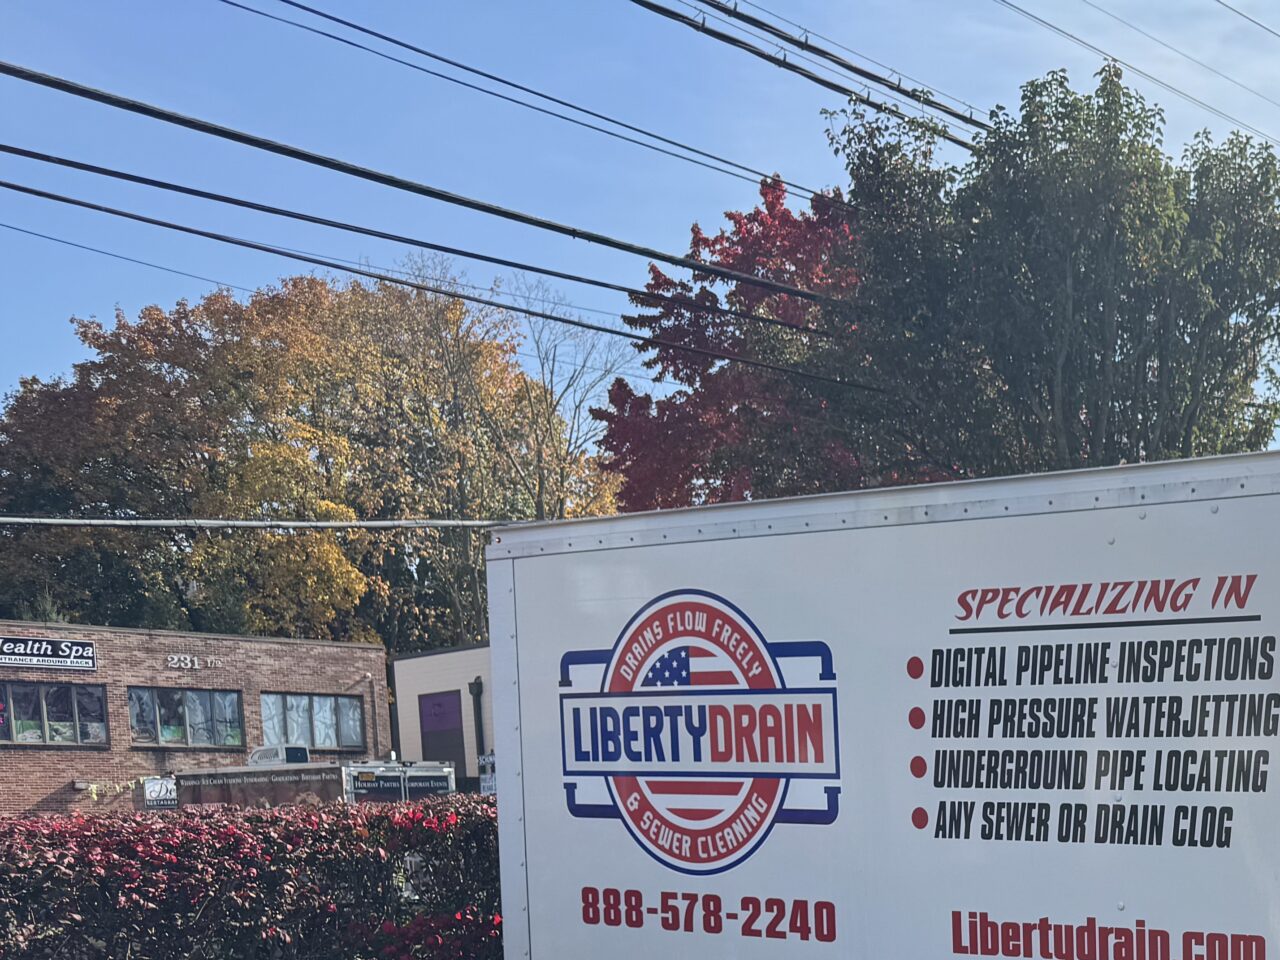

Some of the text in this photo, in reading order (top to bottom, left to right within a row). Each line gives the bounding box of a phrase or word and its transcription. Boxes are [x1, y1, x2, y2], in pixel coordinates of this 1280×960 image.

[954, 573, 1258, 622] SPECIALIZING IN
[36, 658, 69, 666] AROUND
[59, 641, 94, 661] Spa
[167, 654, 200, 669] 231
[620, 610, 762, 682] DRAINS FLOW FREELY
[930, 636, 1276, 688] DIGITAL PIPELINE INSPECTIONS
[572, 703, 825, 764] LIBERTYDRAIN
[931, 693, 1280, 739] HIGH PRESSURE WATERJETTING
[933, 749, 1270, 793] UNDERGROUND PIPE LOCATING
[626, 792, 768, 859] & SEWER CLEANING
[934, 800, 1234, 849] ANY SEWER OR DRAIN CLOG
[581, 886, 837, 943] 888-578-2240
